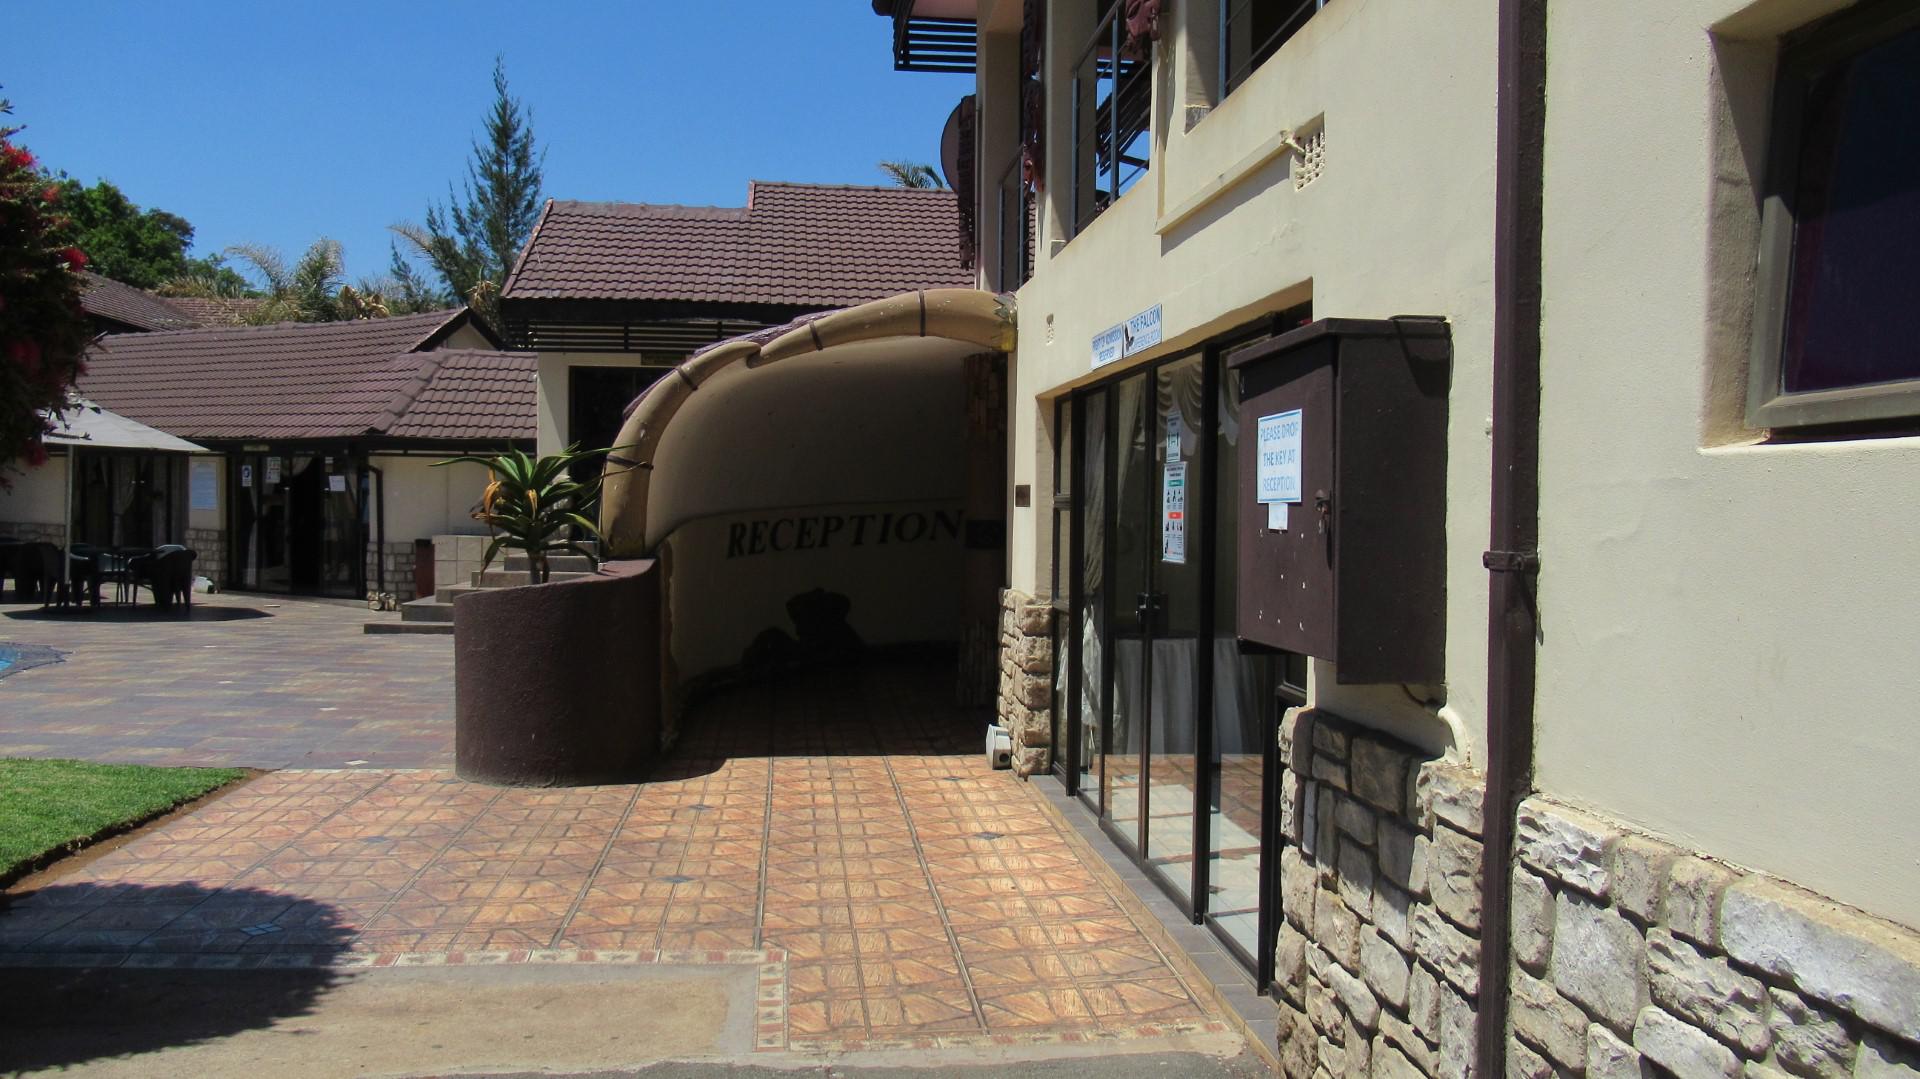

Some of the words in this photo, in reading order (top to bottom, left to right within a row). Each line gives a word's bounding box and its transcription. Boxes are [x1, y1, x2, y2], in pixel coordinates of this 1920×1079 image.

[1140, 307, 1161, 329] FALCON
[1261, 424, 1281, 442] PLEASE
[1281, 421, 1299, 438] DROP
[1263, 451, 1274, 467] THE
[1275, 450, 1287, 465] KEY
[1288, 448, 1297, 463] AT
[1263, 476, 1297, 492] RECEPTION
[726, 508, 964, 560] RECEPTION
